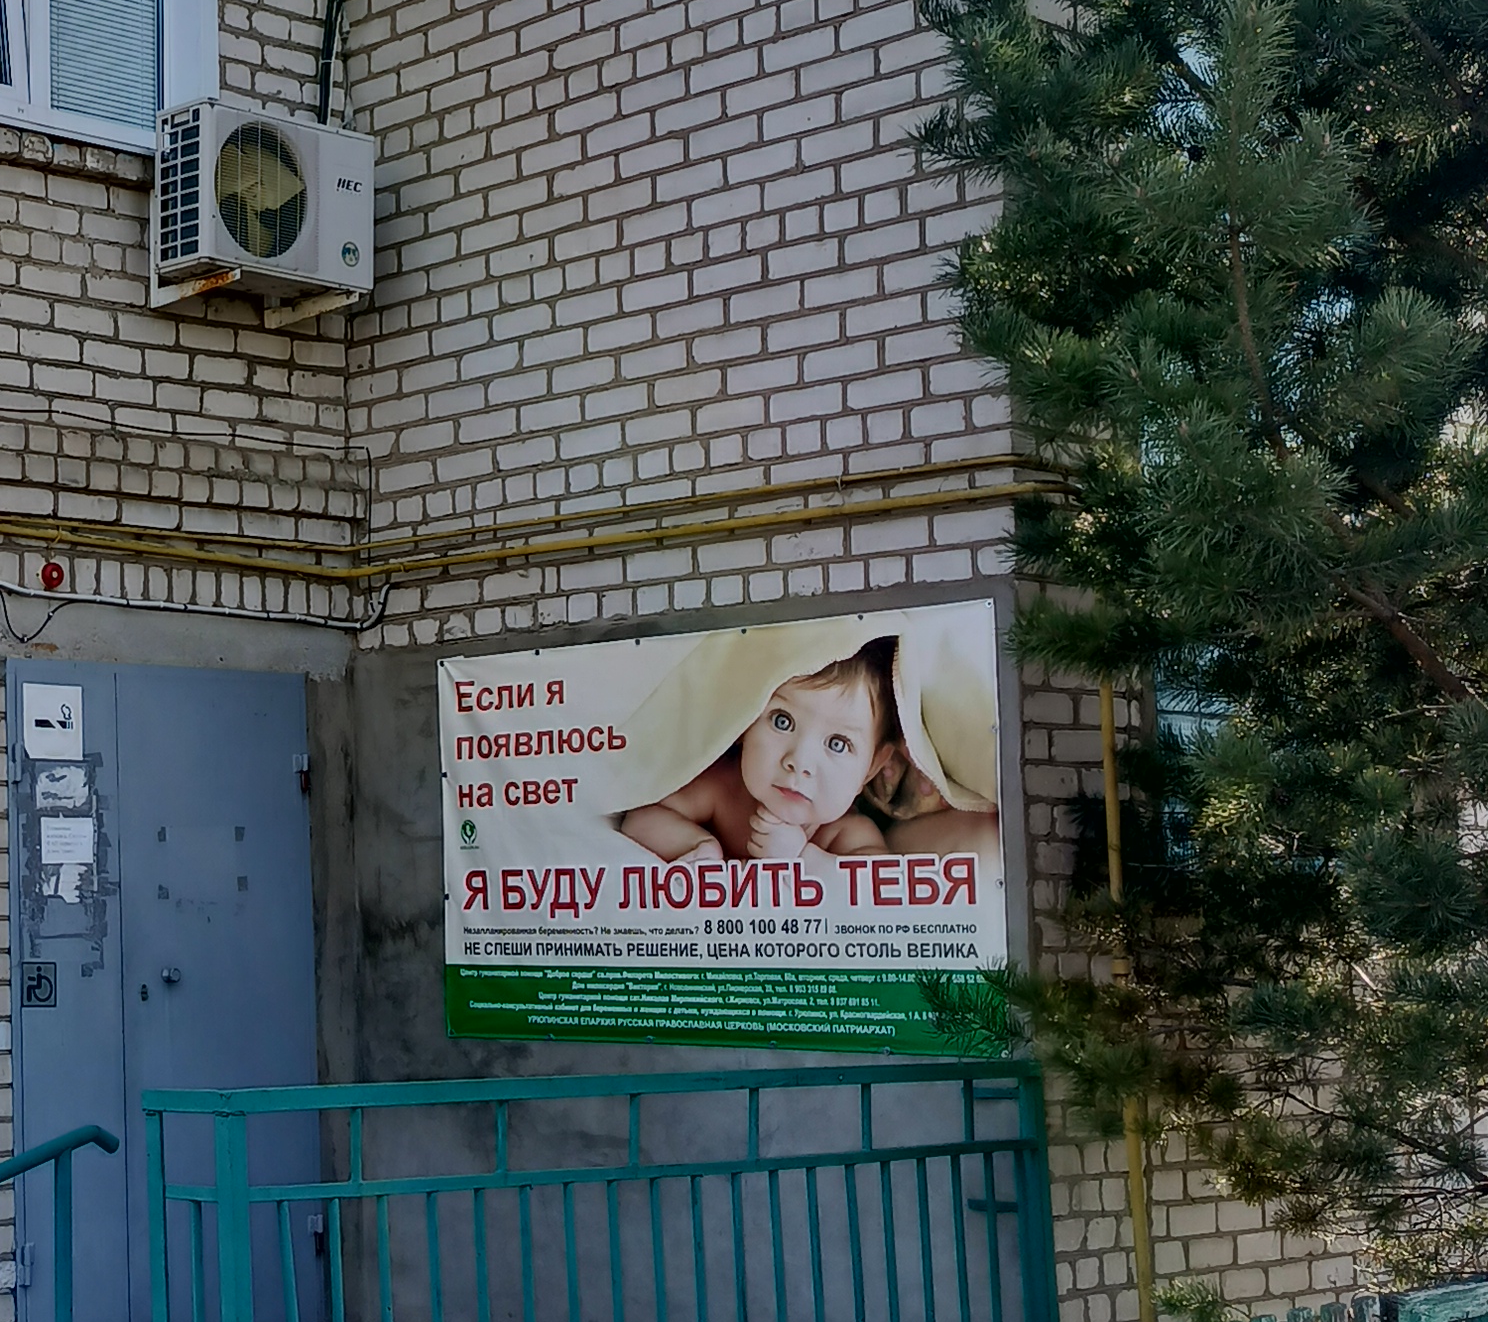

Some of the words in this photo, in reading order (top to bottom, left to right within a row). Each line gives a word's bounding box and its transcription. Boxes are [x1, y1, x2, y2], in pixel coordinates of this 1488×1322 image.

[455, 680, 534, 713] Если
[456, 725, 627, 760] появлюсь
[458, 782, 494, 808] на
[504, 778, 578, 806] свет
[463, 869, 489, 910] Я
[501, 867, 606, 919] БУДУ
[618, 862, 824, 910] ЛЮБИТЬ
[839, 857, 977, 906] ТЕБЯ
[703, 920, 713, 935] 8
[716, 919, 744, 935] 800
[749, 919, 776, 935] 100
[781, 918, 800, 934] 48
[803, 918, 822, 934] 77
[834, 924, 876, 934] ЗВОНОК
[878, 924, 894, 934] ПО
[895, 924, 911, 934] РФ
[913, 924, 977, 934] БЕСПЛАТНО
[464, 942, 481, 956] НЕ
[484, 941, 533, 956] СПЕШИ
[536, 942, 623, 957] ПРИНИМАТЬ
[627, 942, 703, 959] РЕШЕНИЕ,
[706, 943, 750, 960] ЦЕНА
[755, 942, 840, 959] КОТОРОГО
[844, 943, 901, 959] СТОЛЬ
[907, 943, 979, 959] ВЕЛИКА
[617, 1018, 654, 1027] РУССКАЯ
[655, 1019, 723, 1029] ПРАВОСЛАВНАЯ
[724, 1021, 764, 1030] ЦЕРКОВЬ
[832, 1024, 895, 1037] ПАТРИАРХАТ)
